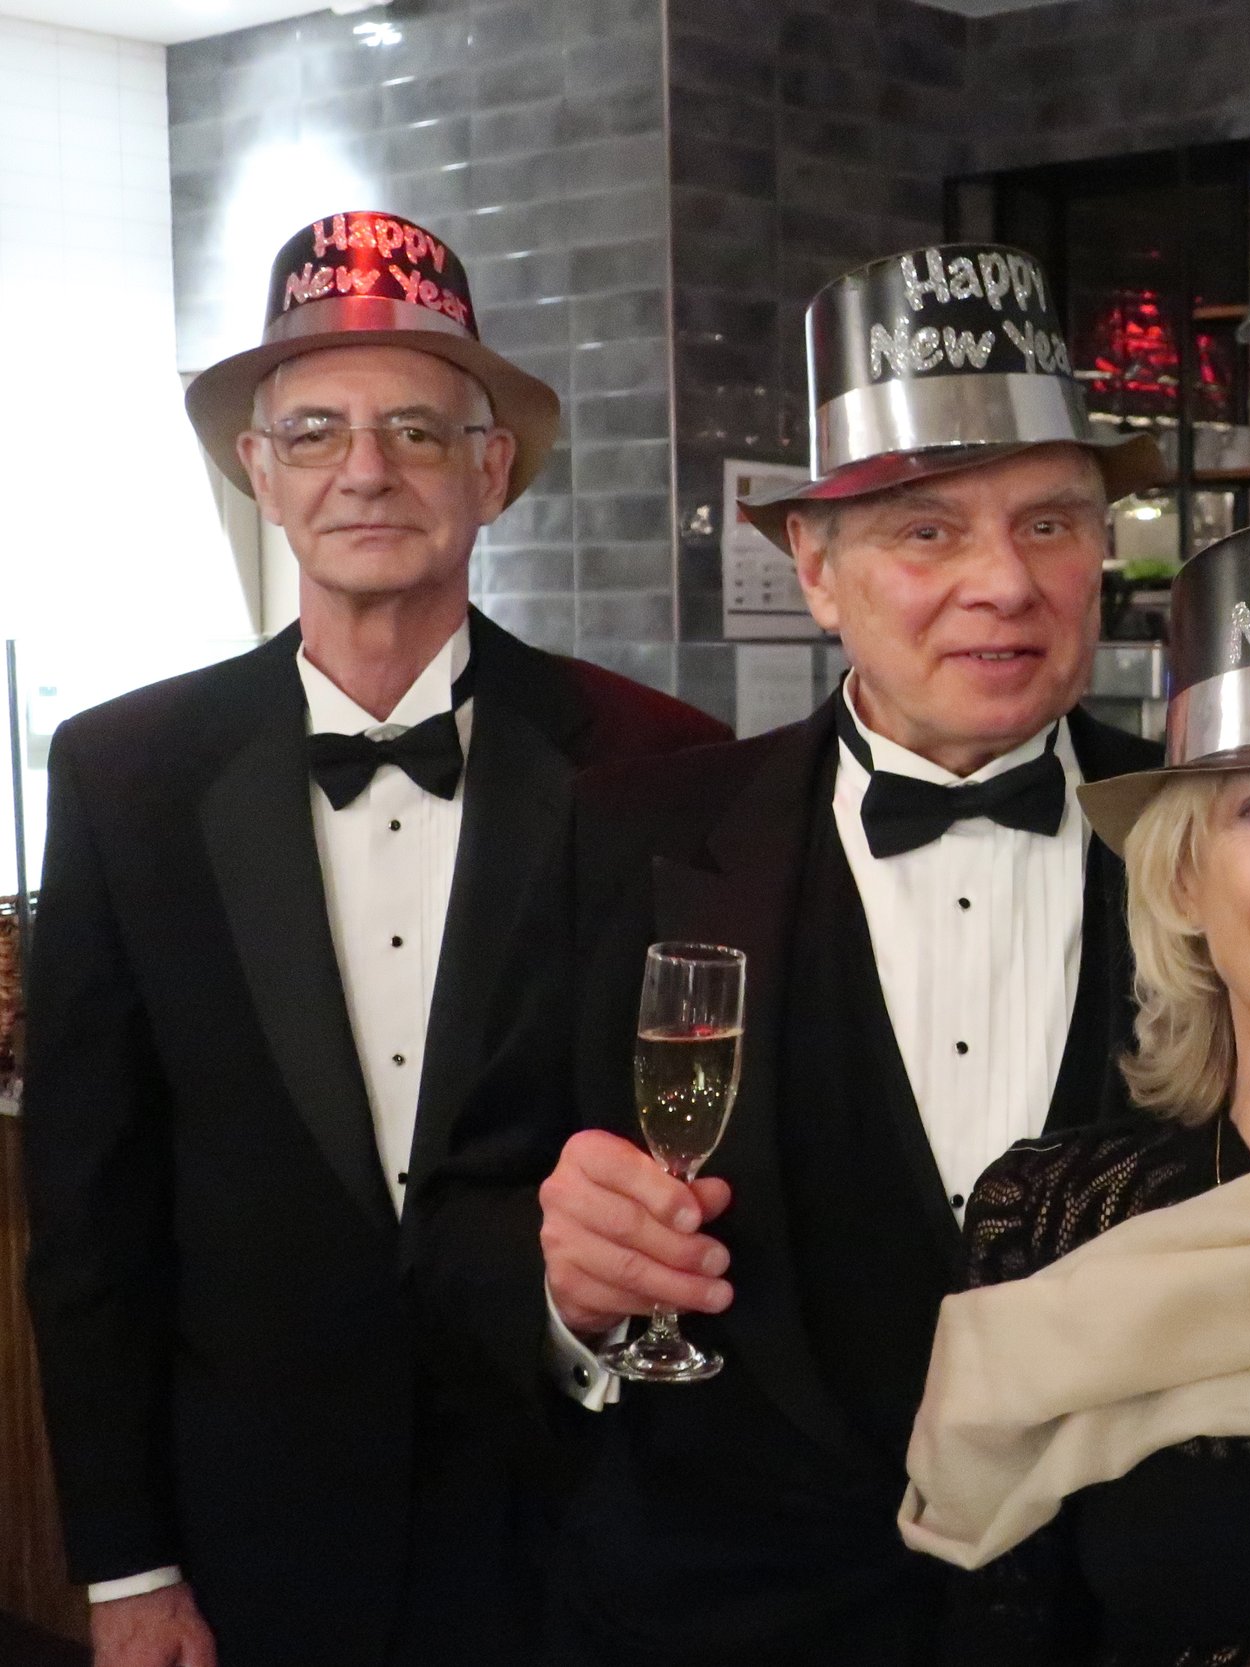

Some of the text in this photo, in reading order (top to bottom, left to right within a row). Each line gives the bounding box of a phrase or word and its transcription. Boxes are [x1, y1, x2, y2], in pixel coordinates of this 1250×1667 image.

[313, 214, 445, 273] Happy
[283, 262, 467, 326] New Year
[901, 249, 1046, 312] Happy
[871, 315, 1072, 380] New Yea
